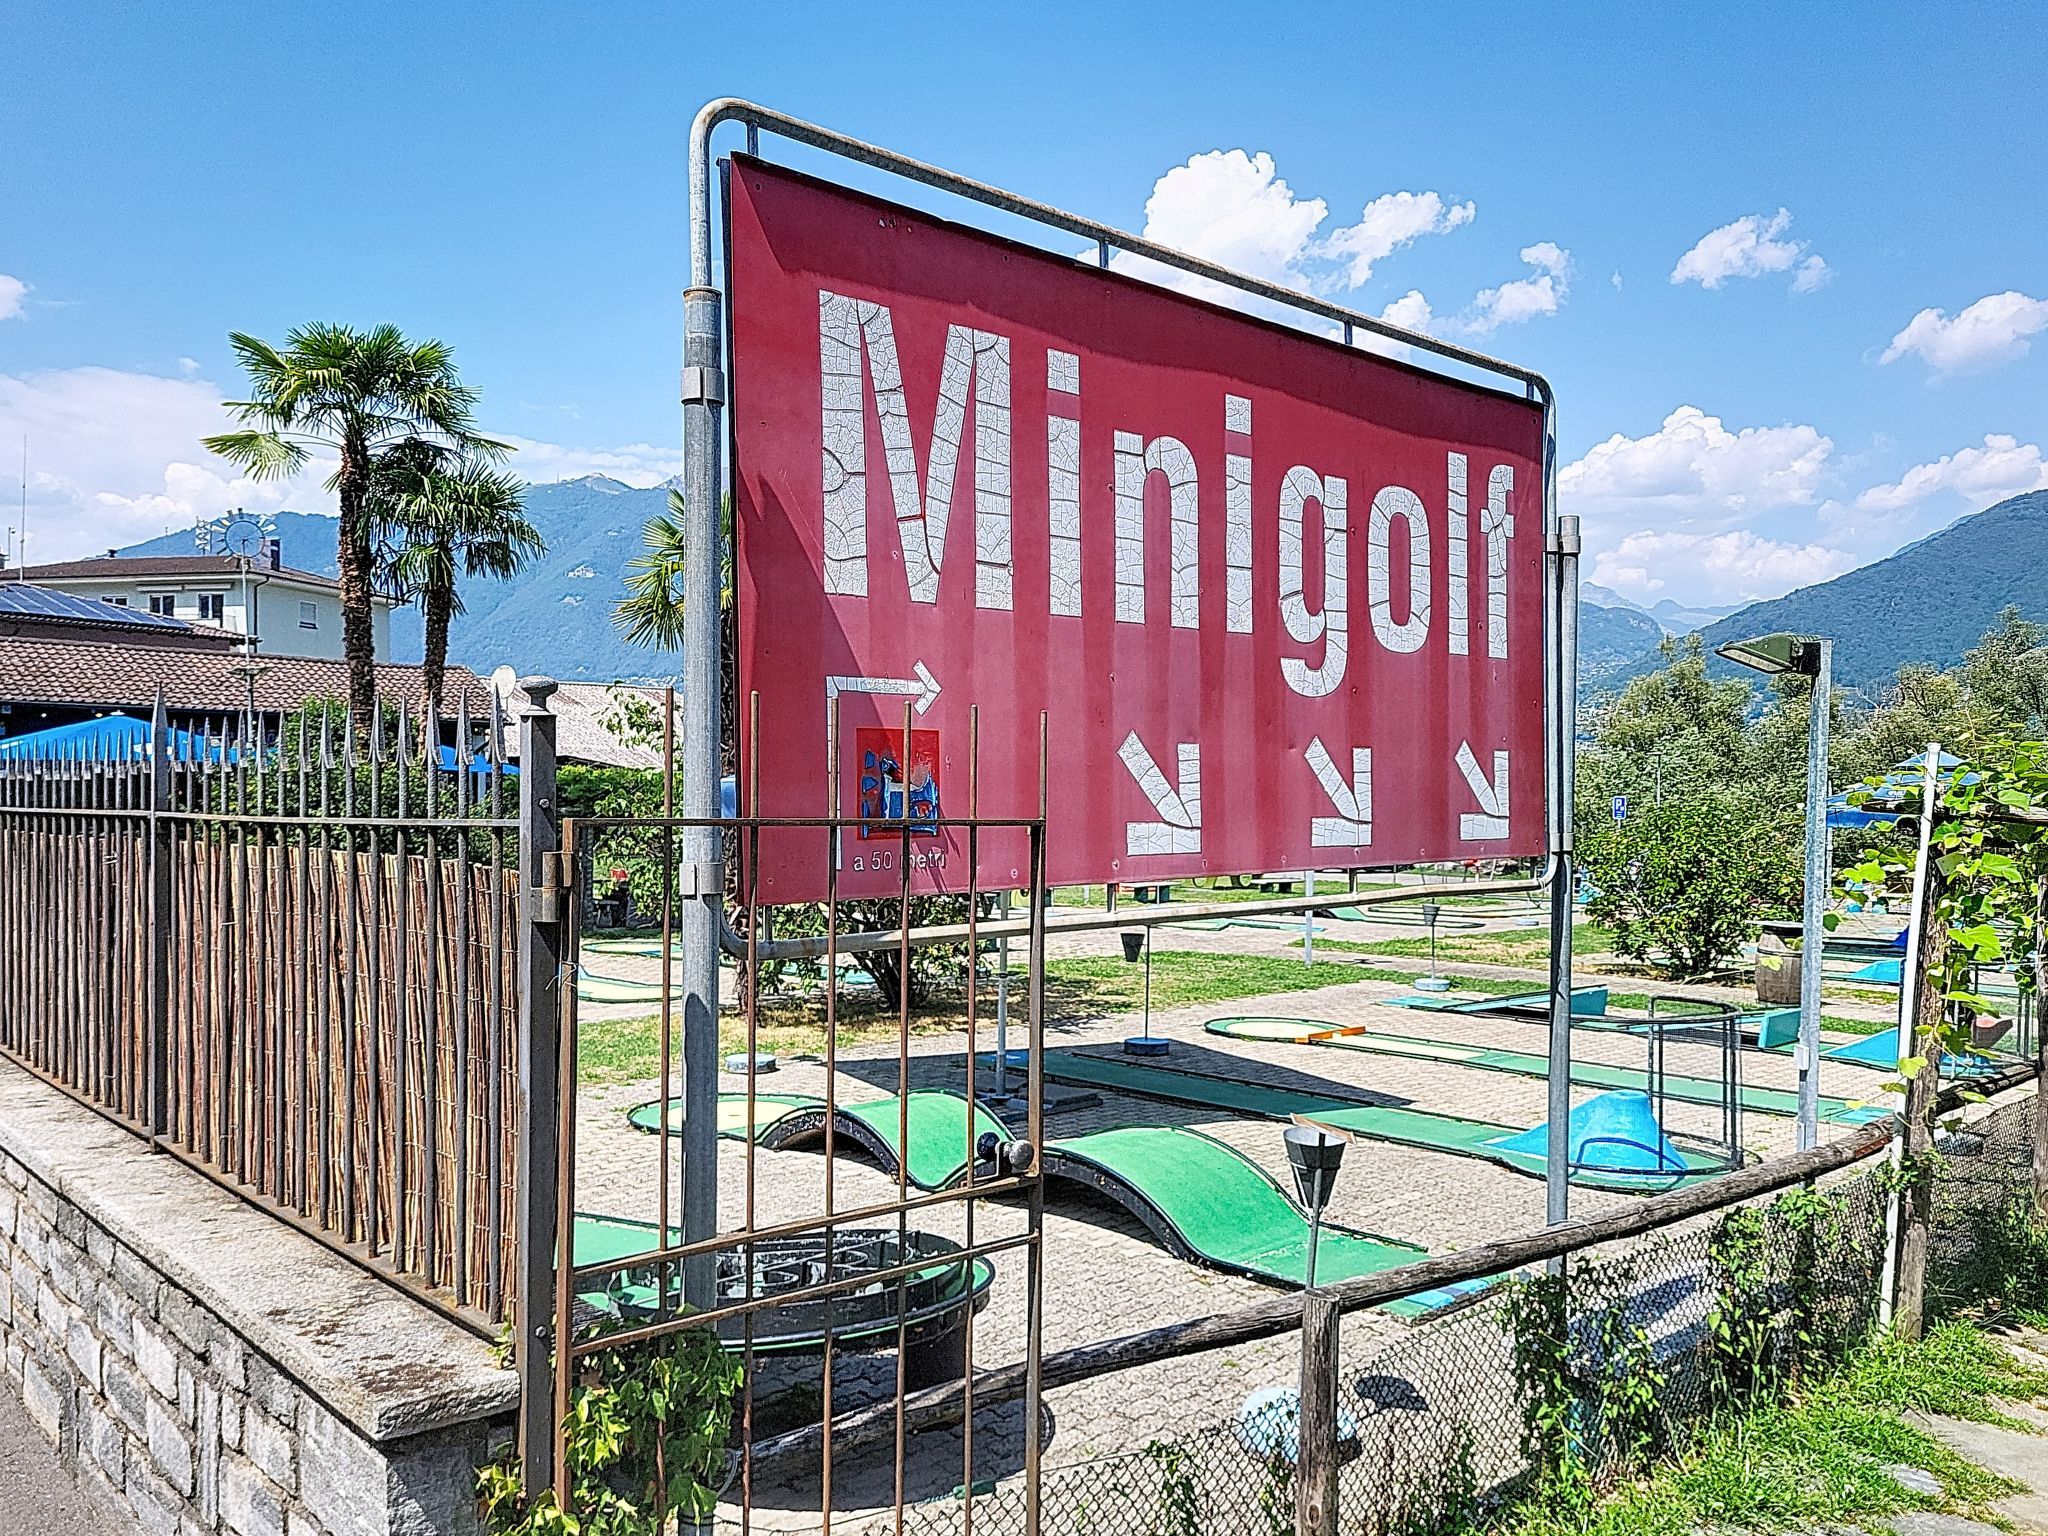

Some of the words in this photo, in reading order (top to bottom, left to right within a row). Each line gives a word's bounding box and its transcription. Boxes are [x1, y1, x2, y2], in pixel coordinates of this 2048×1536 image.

[818, 289, 1514, 697] Minigolf
[853, 855, 865, 871] a
[871, 850, 893, 870] 50
